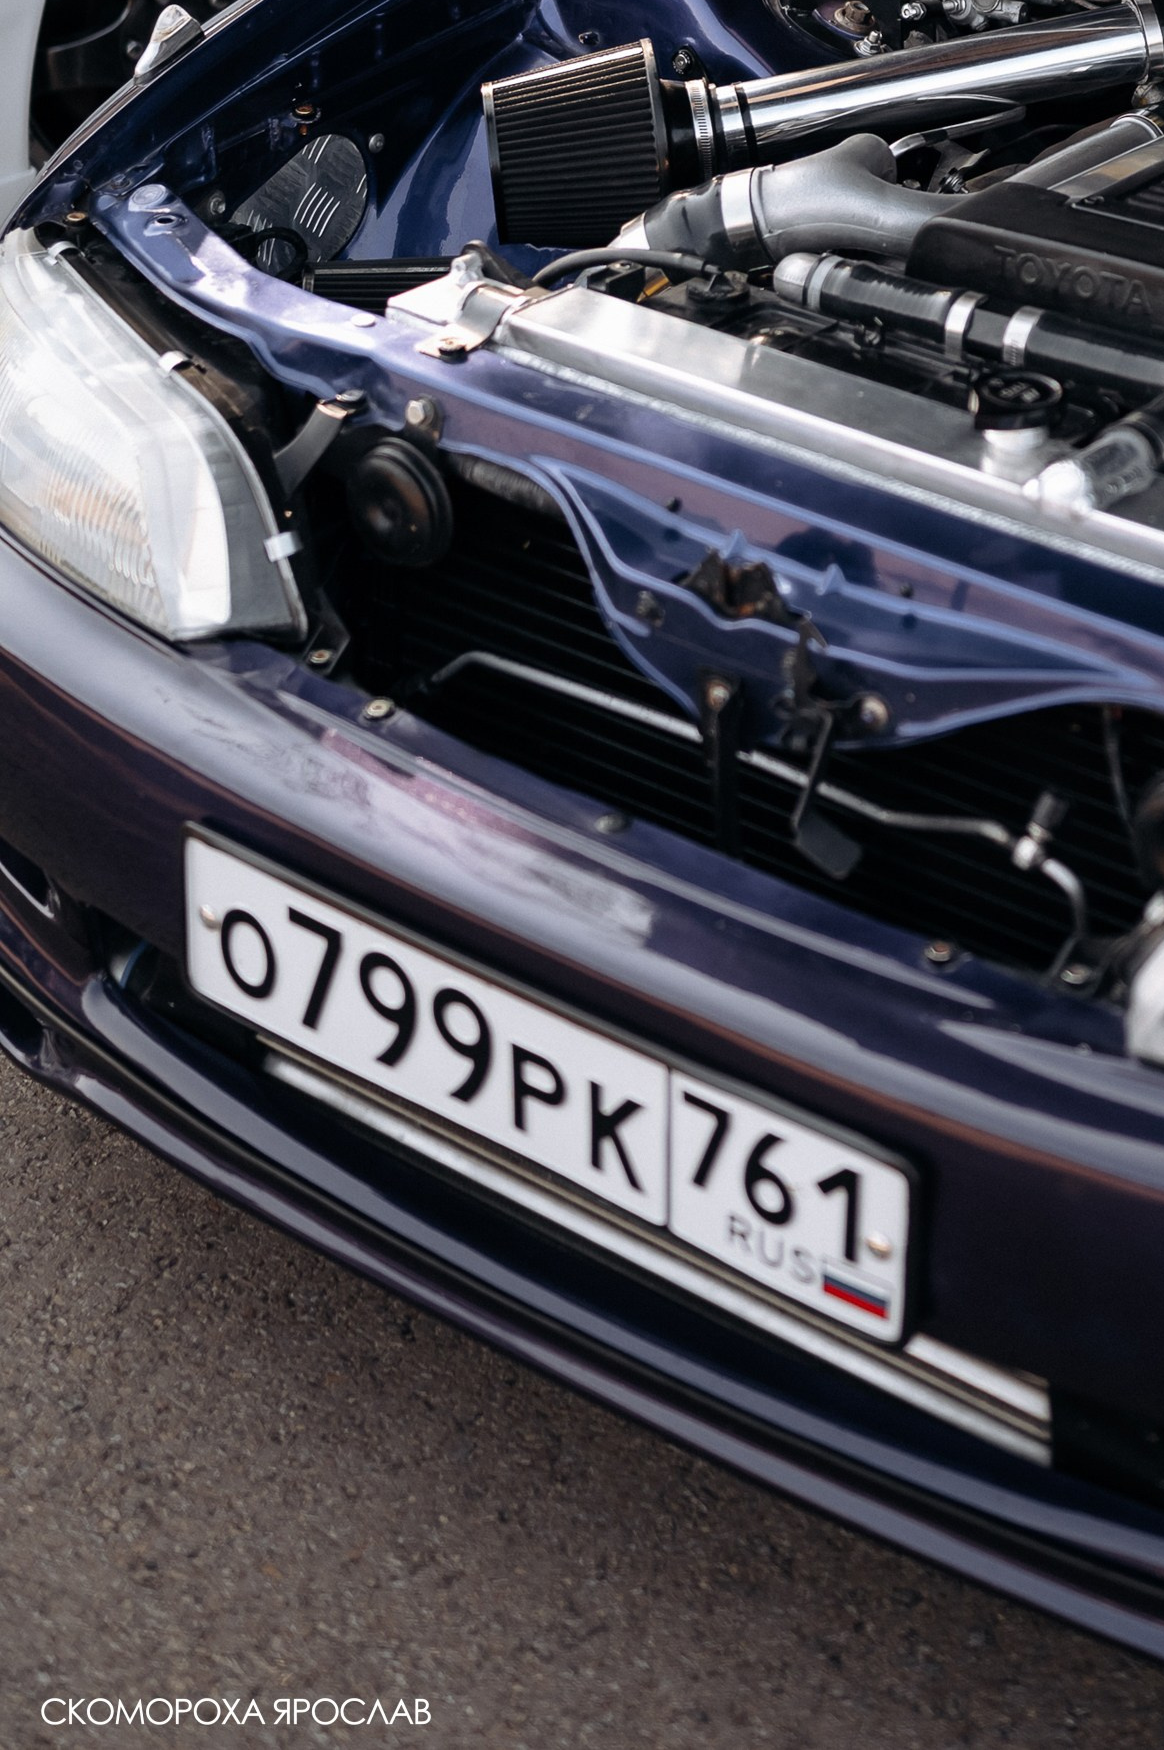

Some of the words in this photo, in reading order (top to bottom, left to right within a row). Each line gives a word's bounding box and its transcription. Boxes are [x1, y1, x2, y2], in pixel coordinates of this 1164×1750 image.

[993, 244, 1152, 316] TOYOTA
[683, 1091, 861, 1264] 761
[728, 1214, 816, 1284] RUS
